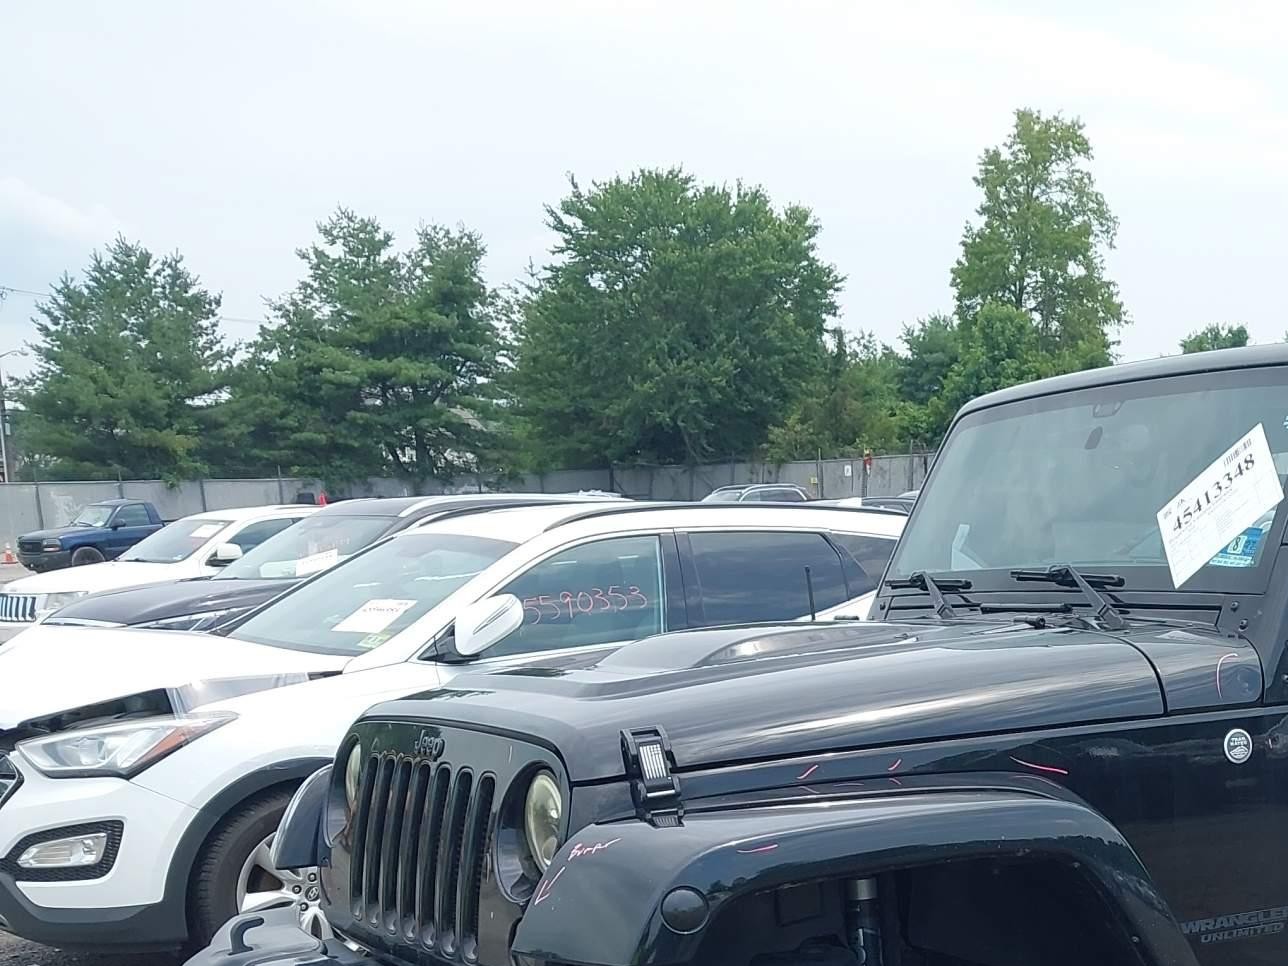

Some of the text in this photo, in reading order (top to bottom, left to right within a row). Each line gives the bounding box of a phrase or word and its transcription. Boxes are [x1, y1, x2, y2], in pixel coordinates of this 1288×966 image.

[1173, 453, 1255, 532] 45413348
[414, 729, 446, 762] Jeep
[1200, 922, 1285, 943] UNLIMITED
